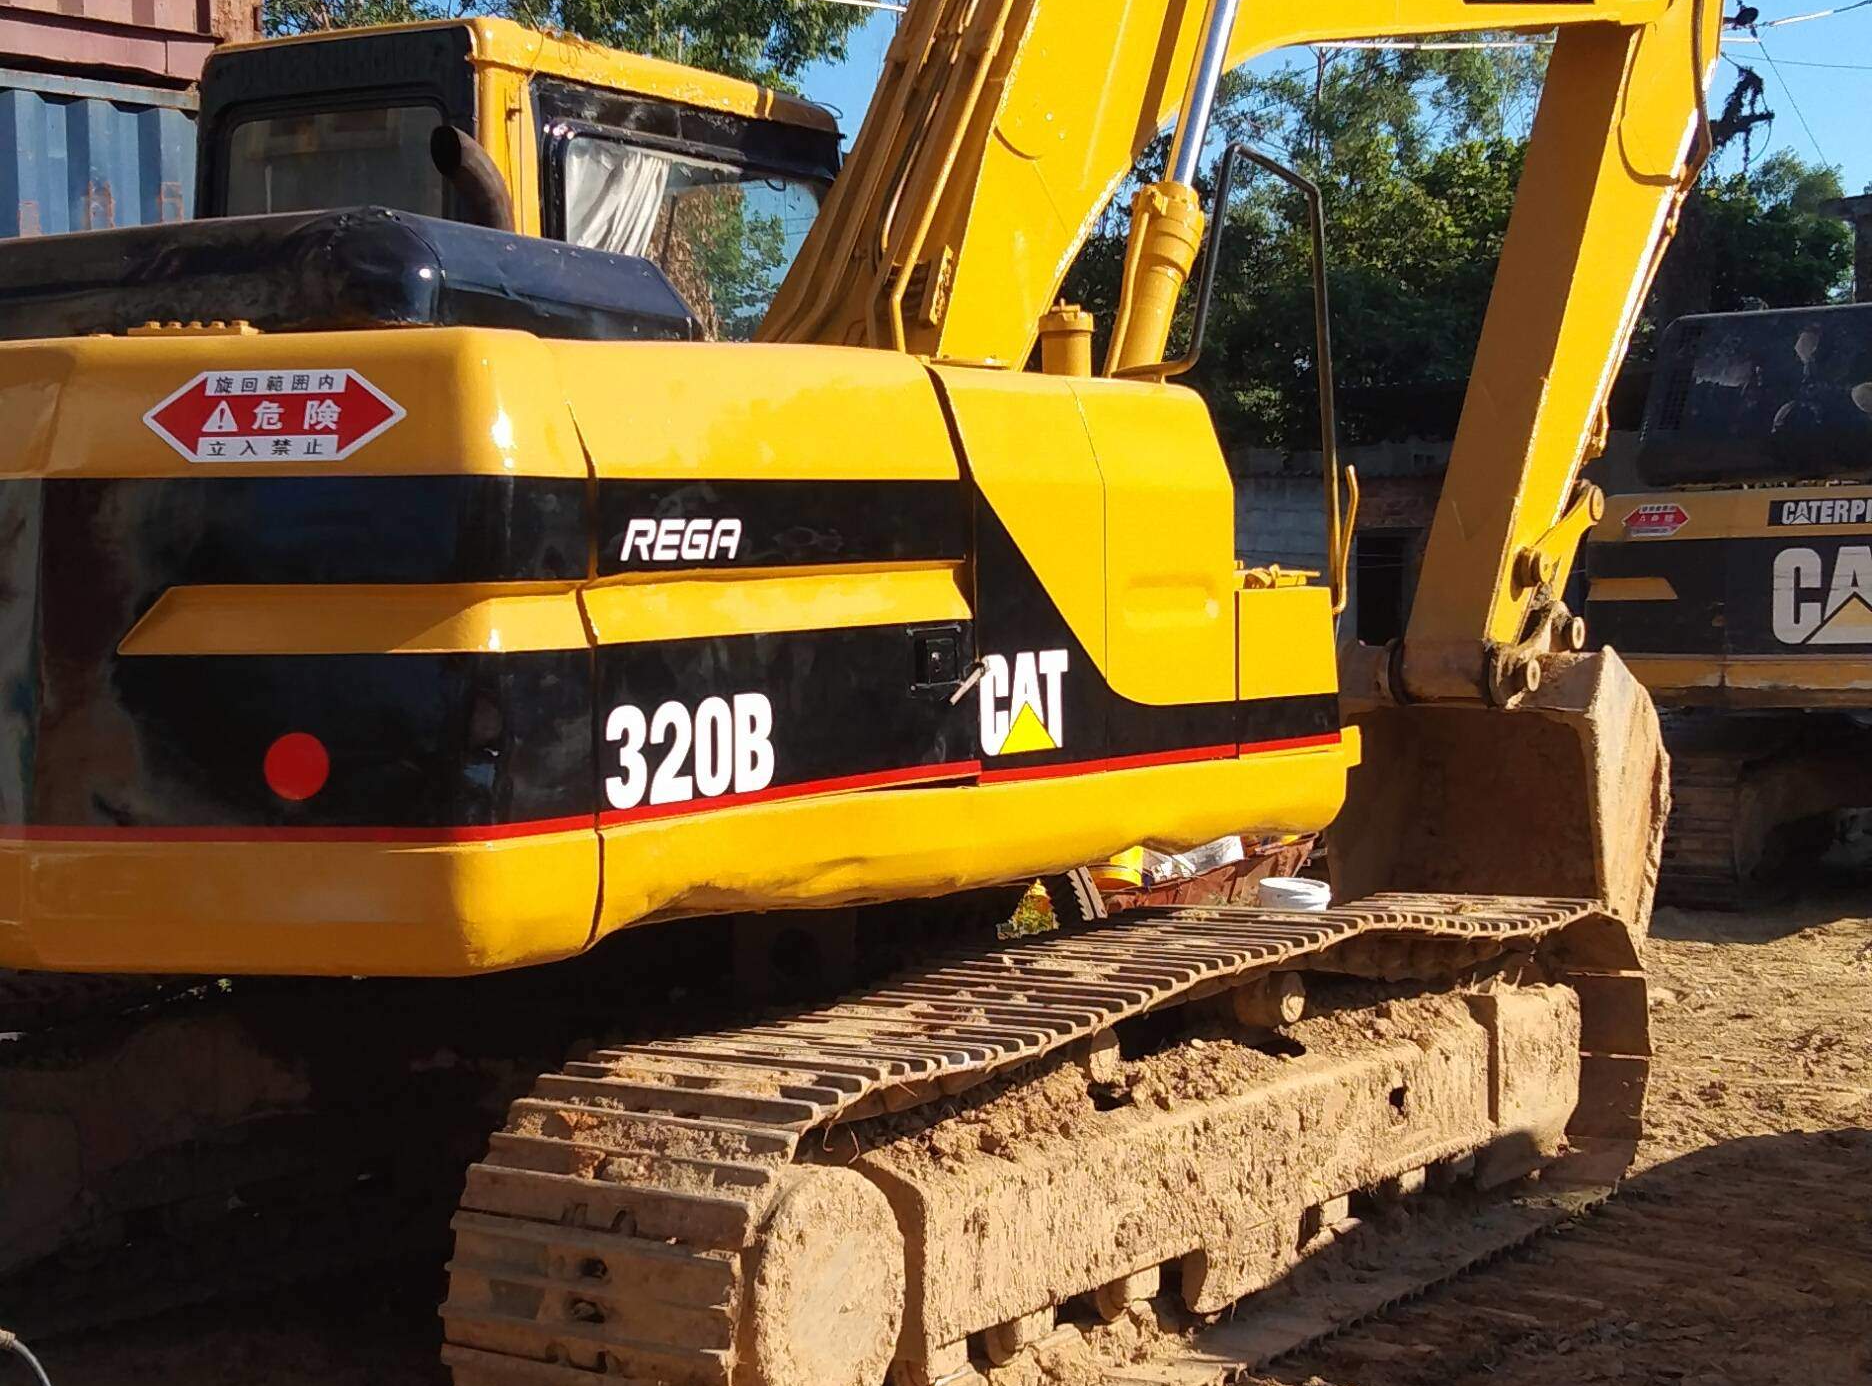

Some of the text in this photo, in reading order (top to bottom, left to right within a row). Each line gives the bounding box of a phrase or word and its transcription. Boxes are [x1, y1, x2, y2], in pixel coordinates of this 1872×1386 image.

[213, 374, 335, 395] 旋回範囲内
[251, 399, 342, 431] 危険
[206, 439, 325, 457] 立入禁止
[620, 518, 742, 562] REGA
[979, 649, 1069, 757] CAT
[605, 693, 775, 810] 320B
